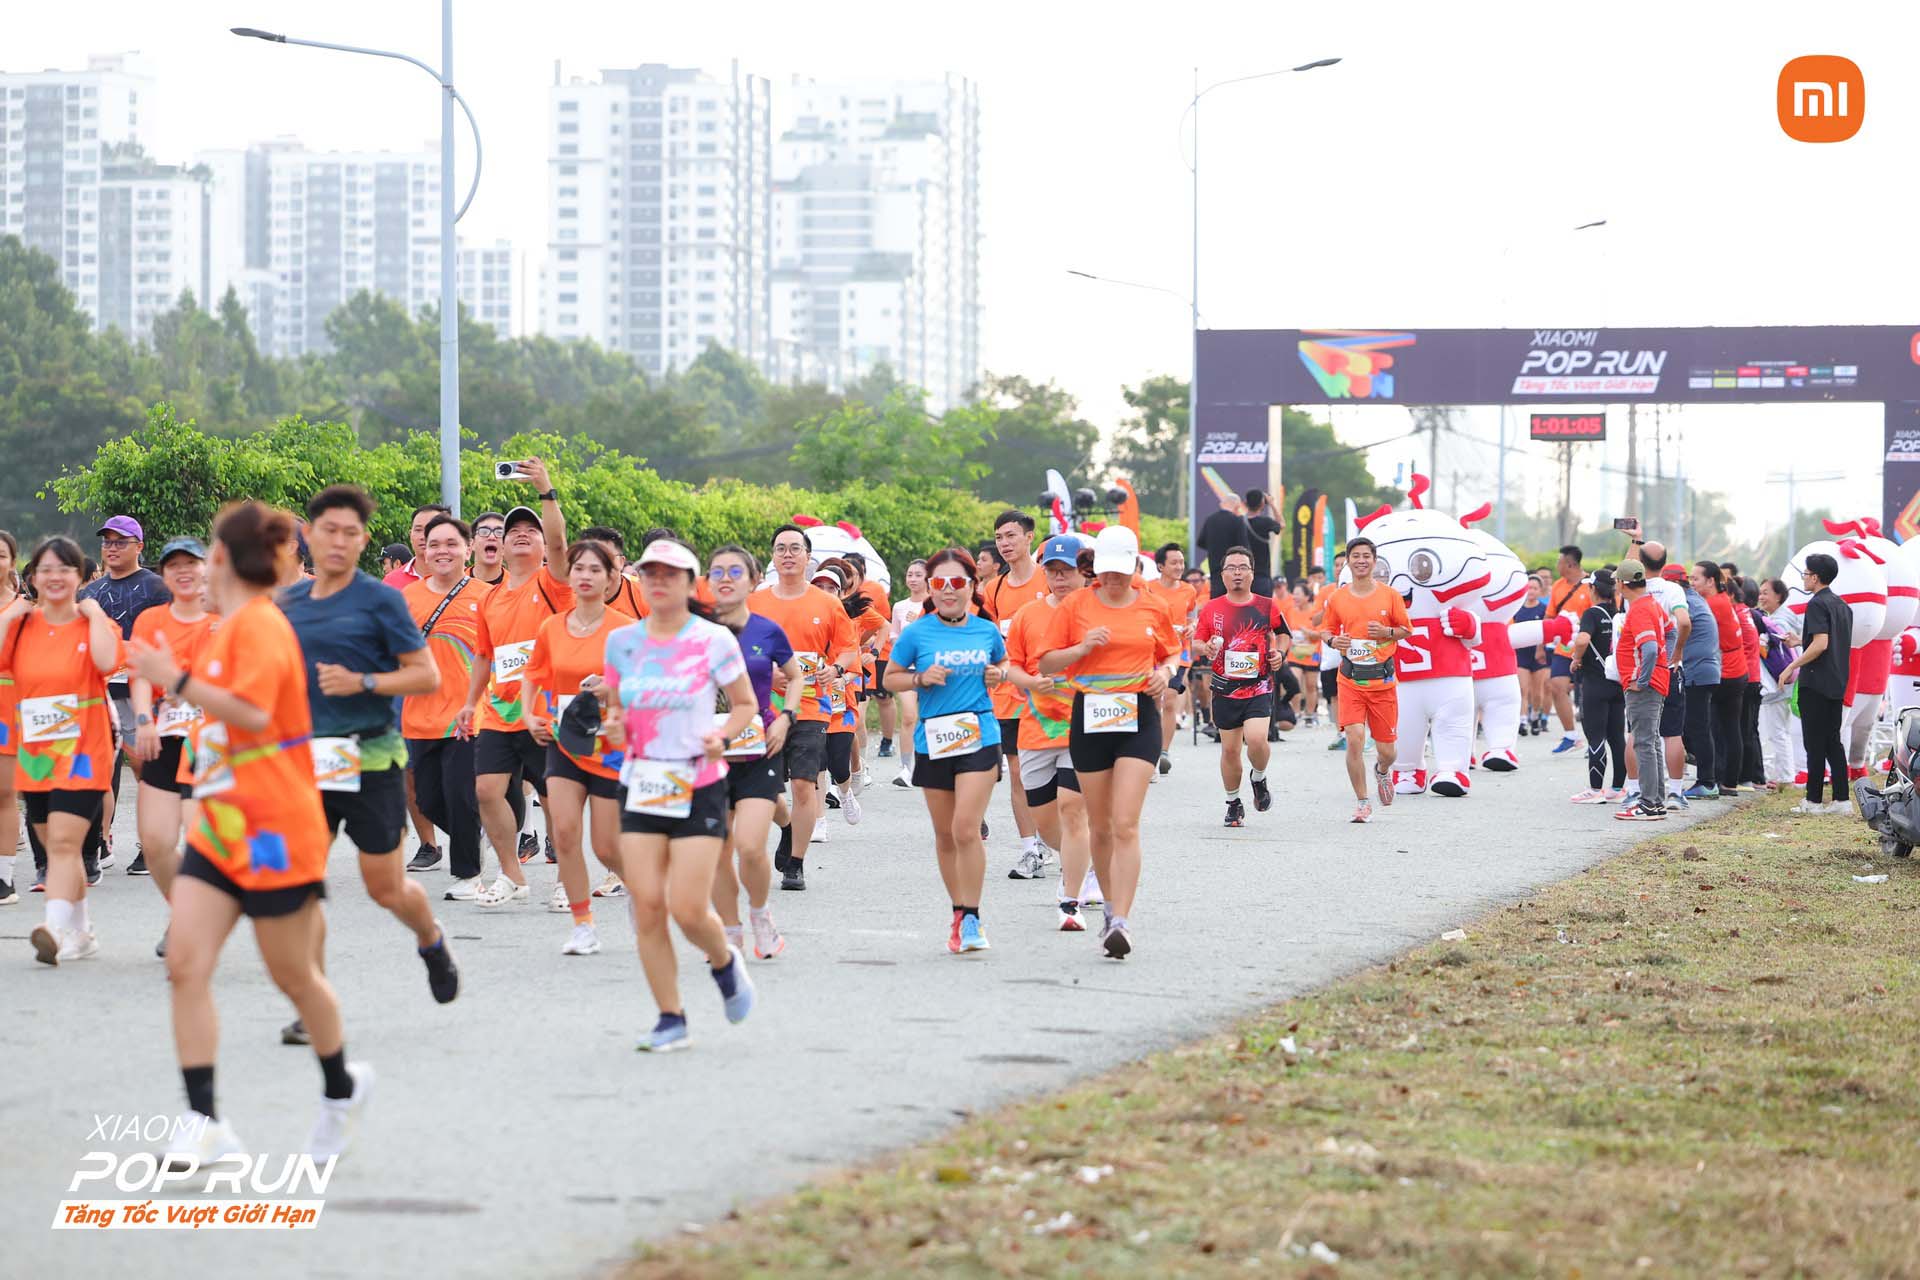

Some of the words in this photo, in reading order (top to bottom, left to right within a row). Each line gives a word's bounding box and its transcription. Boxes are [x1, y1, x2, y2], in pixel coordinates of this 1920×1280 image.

[1529, 330, 1598, 347] XIAOMI
[1520, 350, 1593, 374] POP
[1593, 350, 1668, 374] RUN
[1531, 416, 1603, 435] 1:01:05
[1200, 440, 1236, 453] POP
[1234, 440, 1269, 453] RUN
[934, 650, 989, 667] HOKA
[1230, 661, 1254, 669] 52072
[1093, 707, 1127, 718] 50109
[935, 729, 970, 744] 51060
